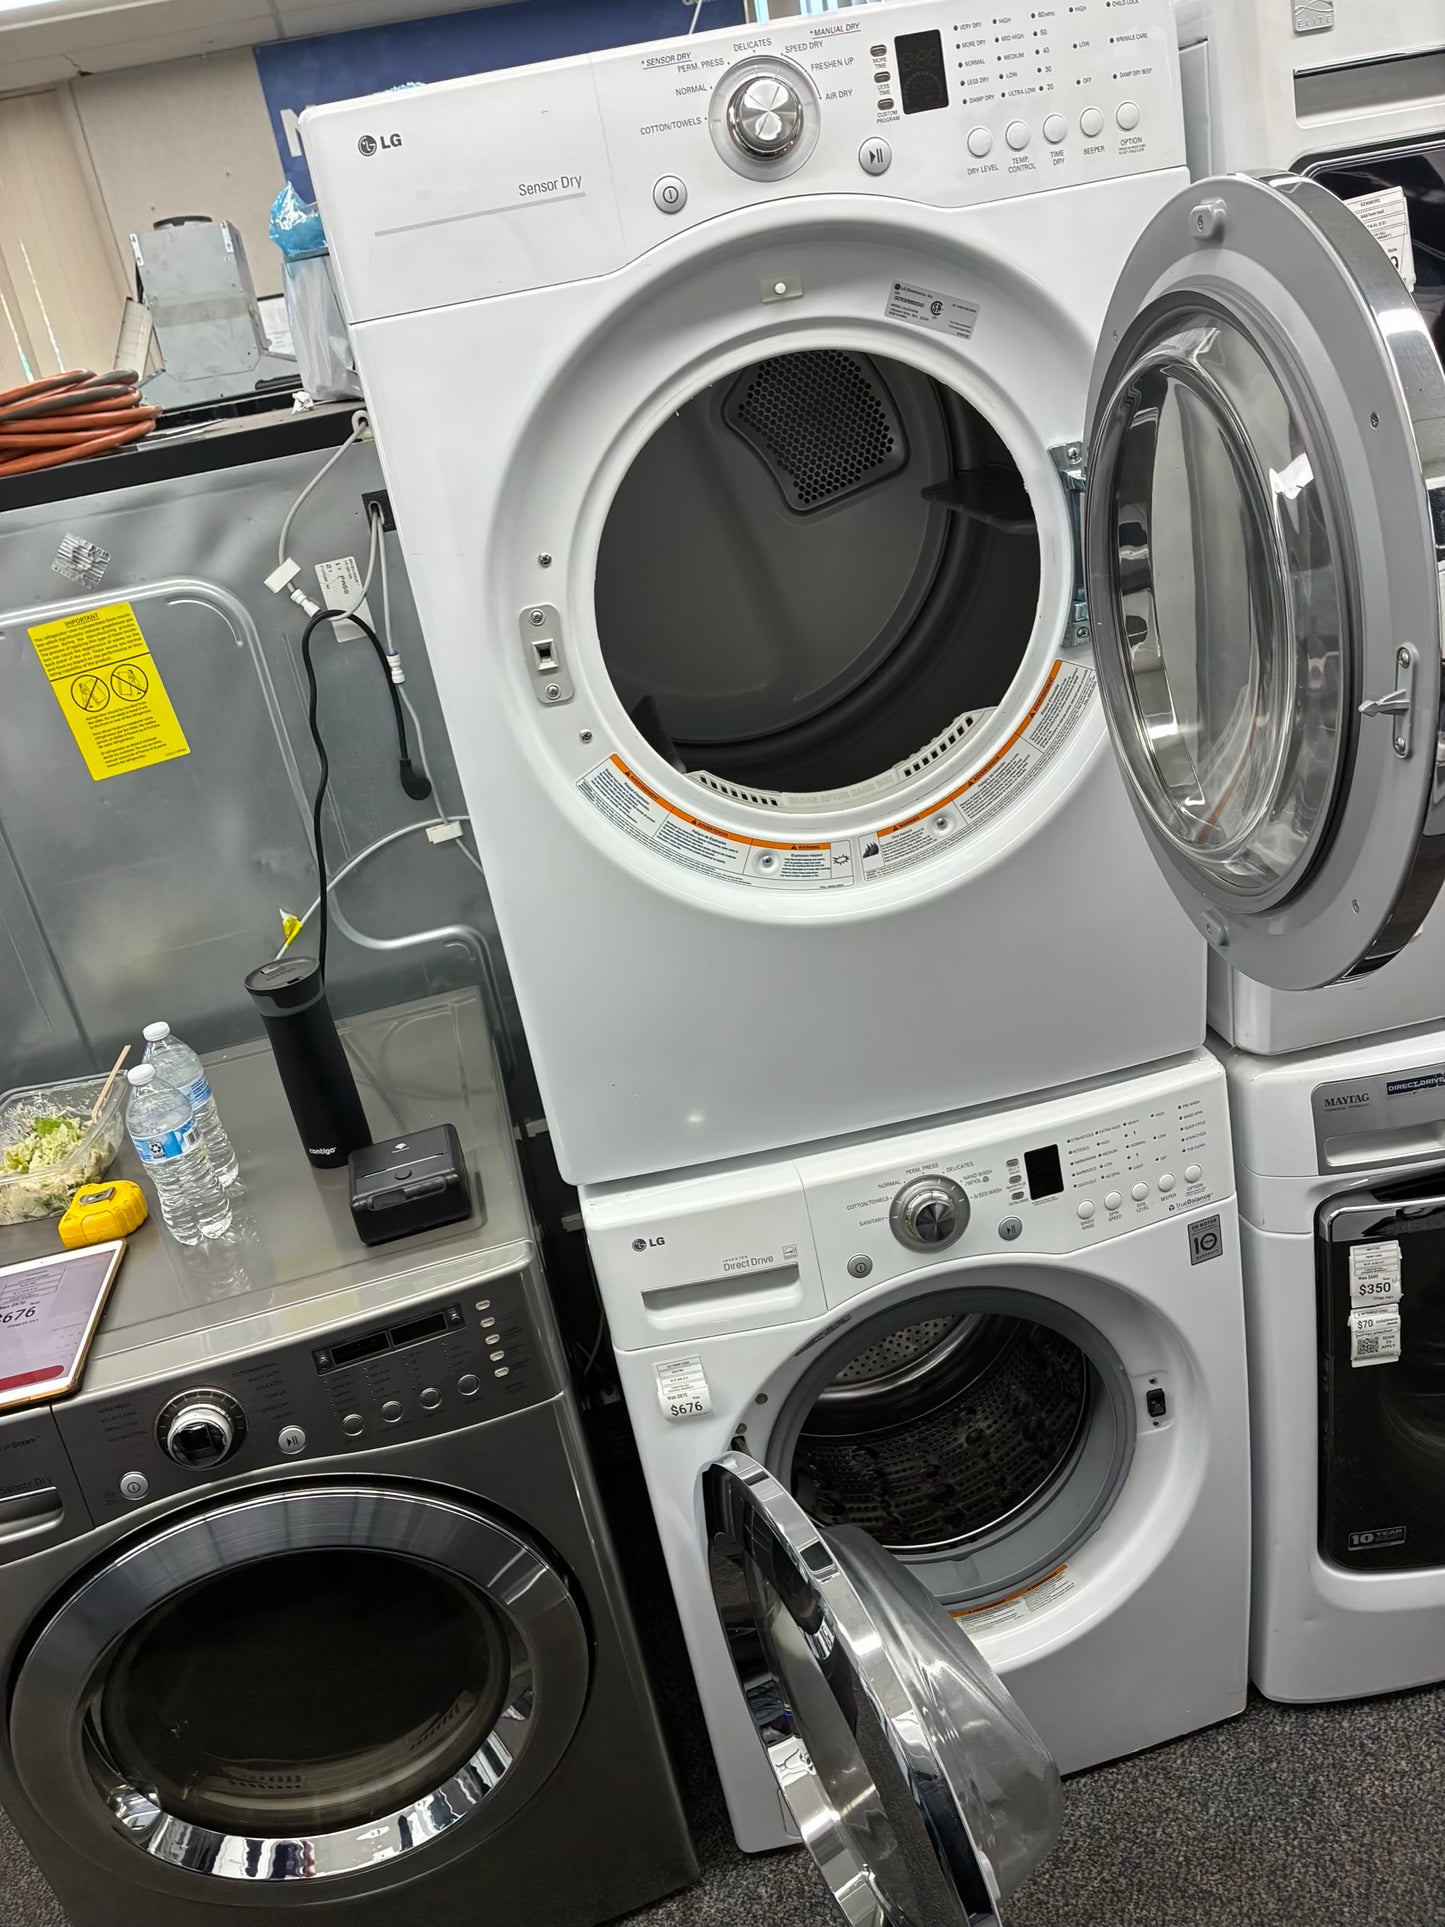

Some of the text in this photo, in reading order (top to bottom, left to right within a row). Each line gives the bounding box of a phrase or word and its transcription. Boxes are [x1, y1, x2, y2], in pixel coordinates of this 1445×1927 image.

[1298, 15, 1332, 27] ELITE
[813, 22, 860, 37] MANUAL DRY
[959, 23, 971, 31] VERY
[1116, 32, 1148, 42] WRINKLE CARE
[733, 38, 772, 52] DELICATES
[785, 39, 823, 53] SPEED DRY
[961, 41, 975, 49] MORE
[646, 52, 691, 67] SENSOR DRY
[1003, 52, 1024, 61] MEDIUM
[677, 57, 725, 73] PERM. PRESS
[811, 57, 855, 71] FRESHEN UP
[964, 59, 985, 67] NORMAL
[1044, 65, 1052, 73] 30
[1141, 67, 1152, 75] BEEP
[967, 76, 989, 86] LESS DRY
[675, 84, 707, 96] NORMAL
[825, 88, 853, 101] AIR DRY
[1008, 89, 1024, 97] ULTRA
[969, 94, 995, 104] DAMP DRY
[877, 110, 898, 118] CUSTOM
[640, 116, 702, 135] COTTON/TOWELS
[877, 116, 900, 124] PROGRAM
[380, 133, 402, 150] LG
[1120, 136, 1143, 147] OPTION
[1050, 149, 1065, 158] TIME
[1083, 145, 1105, 156] BEEPER
[1053, 158, 1065, 166] DRY
[967, 164, 999, 175] DRY LEVEL
[1008, 163, 1037, 174] CONTROL
[518, 175, 582, 197] Sensor Dry
[340, 575, 350, 595] PASS
[64, 612, 99, 627] IMPORTANT
[1388, 1080, 1420, 1092] DIRECT
[1324, 1093, 1369, 1107] MAYTAG
[309, 1147, 336, 1156] contigo
[922, 1162, 939, 1171] PRESS
[946, 1161, 974, 1173] DELICATES
[978, 1169, 993, 1177] WASH
[877, 1179, 902, 1189] NORMAL
[1186, 1183, 1204, 1192] OPTION
[989, 1187, 1003, 1196] WASH
[1160, 1193, 1177, 1201] BEEPER
[846, 1195, 889, 1211] COTTON/TOWELS
[1136, 1205, 1149, 1213] LEVEL
[859, 1217, 885, 1227] SANITARY
[1108, 1214, 1122, 1222] SPEED
[1199, 1218, 1217, 1228] MOTOR
[648, 1236, 665, 1247] LG
[1194, 1232, 1217, 1255] 10
[723, 1255, 774, 1271] Direct Drive
[1359, 1281, 1391, 1296] $350
[1357, 1319, 1374, 1330] $70
[670, 1401, 703, 1417] $676
[0, 1475, 52, 1497] Sensor Dry
[1352, 1529, 1403, 1545] 10 YEAR
